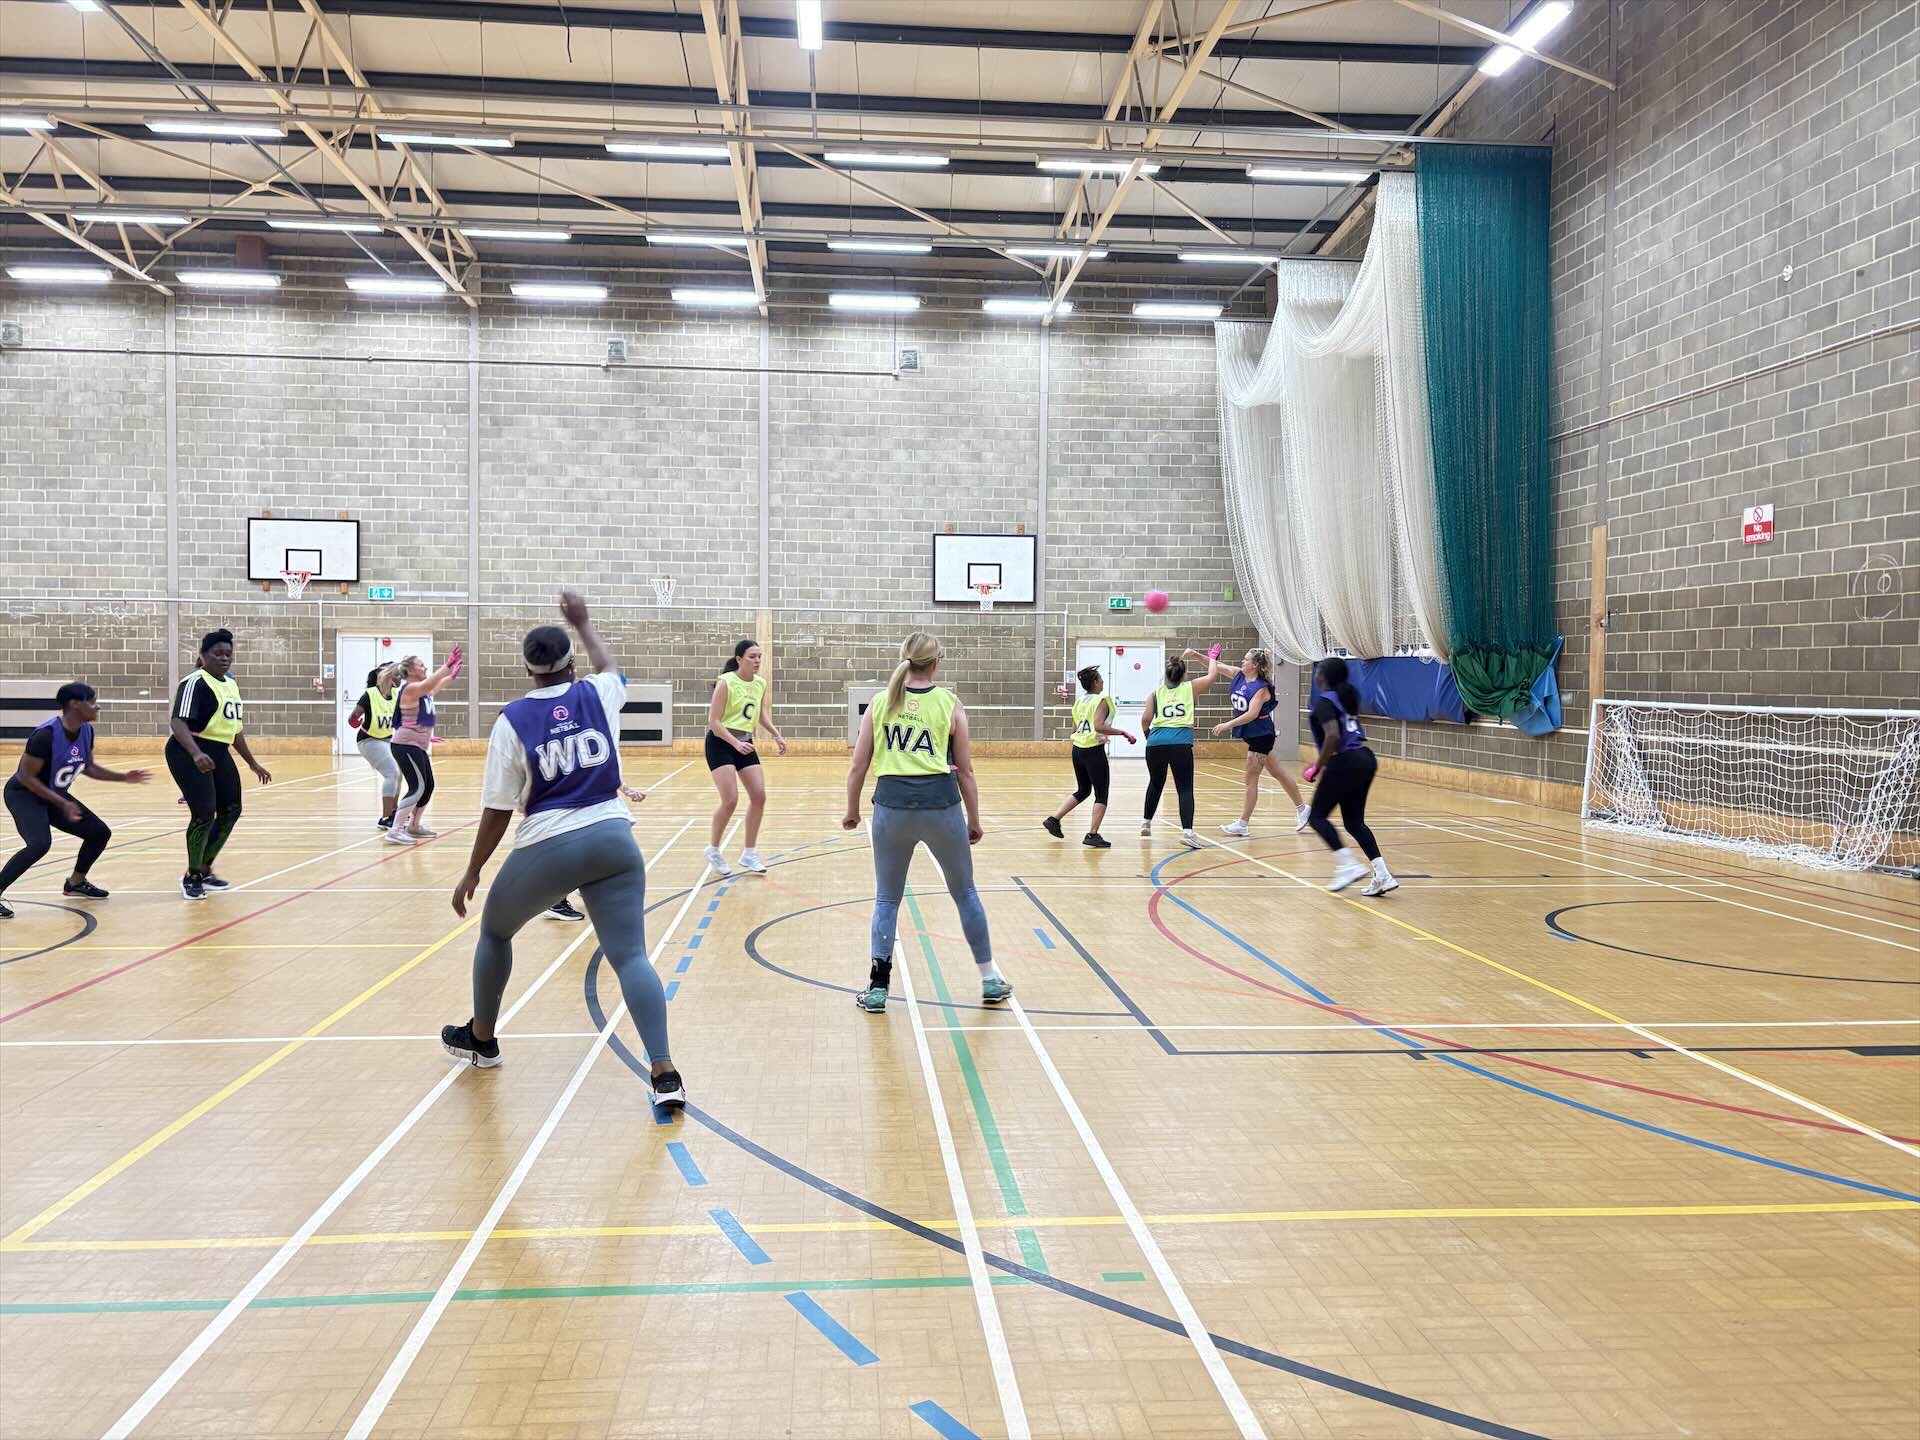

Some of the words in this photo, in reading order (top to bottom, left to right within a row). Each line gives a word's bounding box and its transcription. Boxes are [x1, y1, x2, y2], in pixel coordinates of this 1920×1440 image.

[1745, 531, 1771, 543] smoking
[1753, 524, 1763, 533] No
[1162, 703, 1186, 718] GS
[1230, 693, 1248, 711] GD
[743, 703, 755, 720] C
[884, 724, 936, 757] WA
[535, 728, 610, 781] WD
